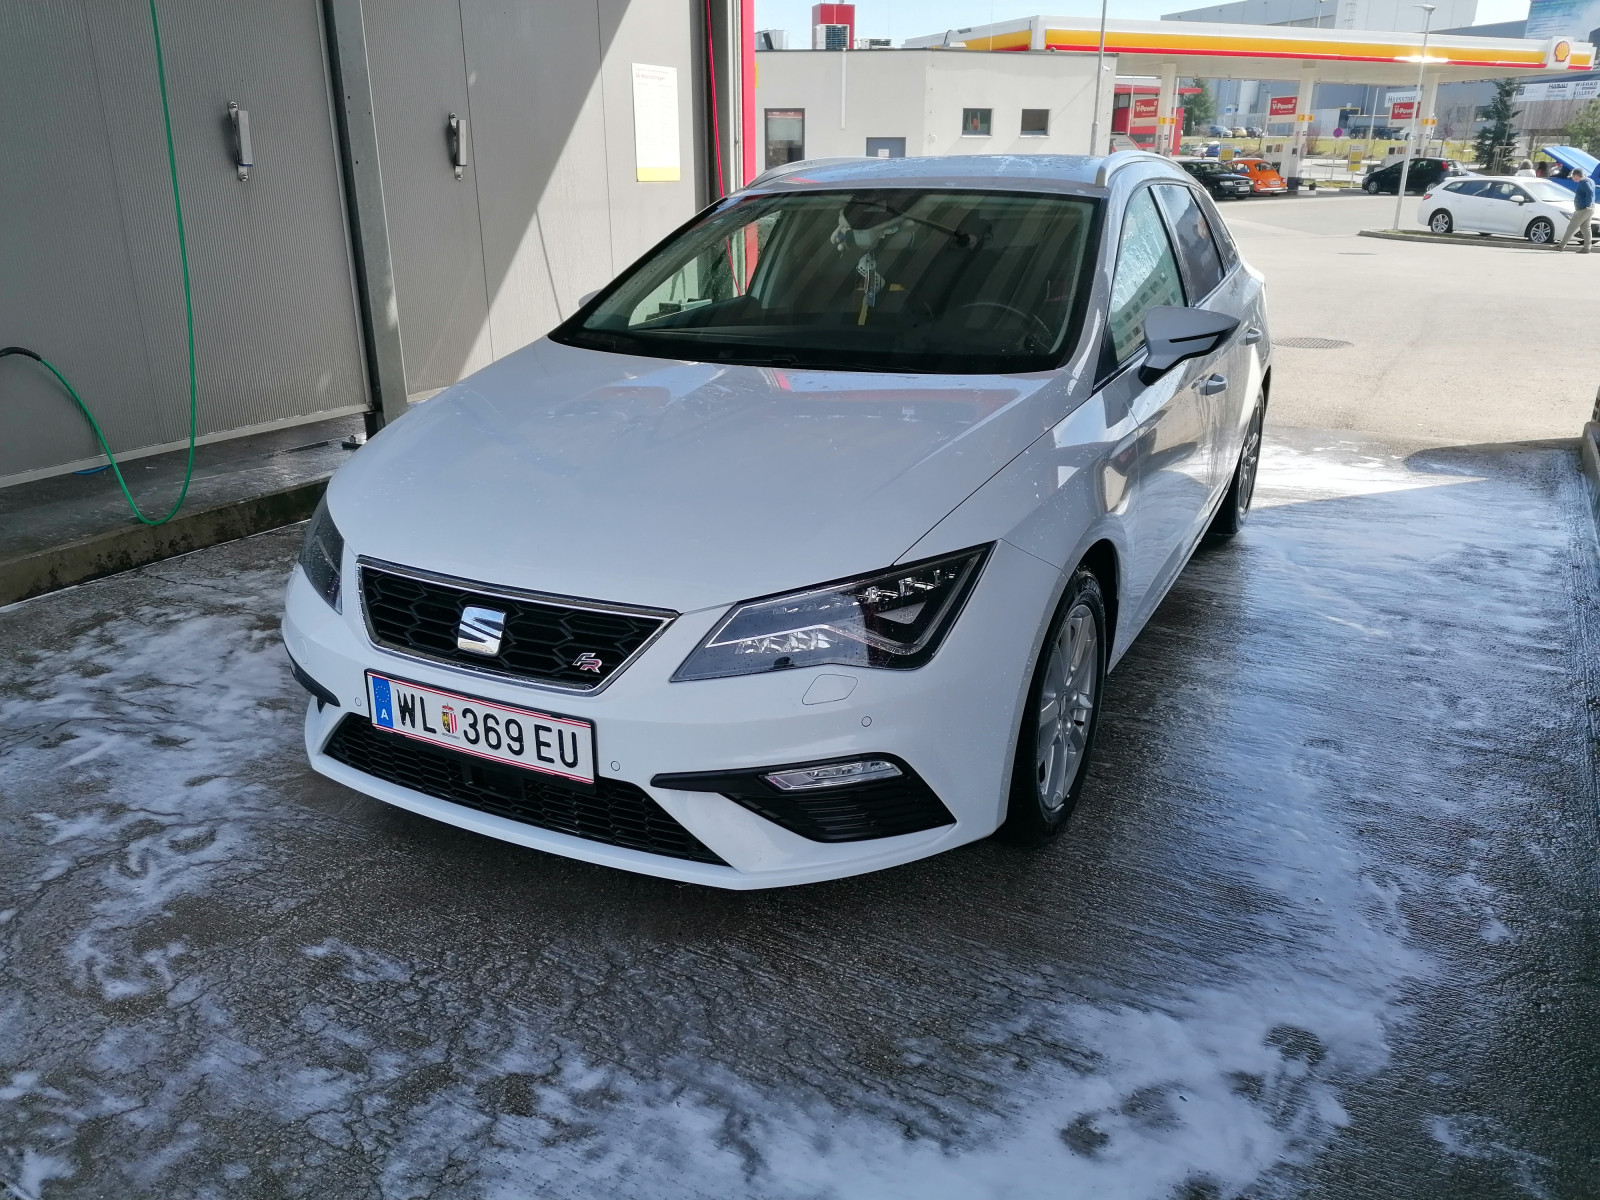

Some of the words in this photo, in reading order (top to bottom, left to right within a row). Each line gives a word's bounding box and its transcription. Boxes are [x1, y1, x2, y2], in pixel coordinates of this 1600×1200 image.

[571, 652, 603, 674] FR
[380, 707, 390, 721] A
[396, 688, 437, 735] WL
[462, 707, 525, 756] 369
[534, 723, 579, 769] EU
